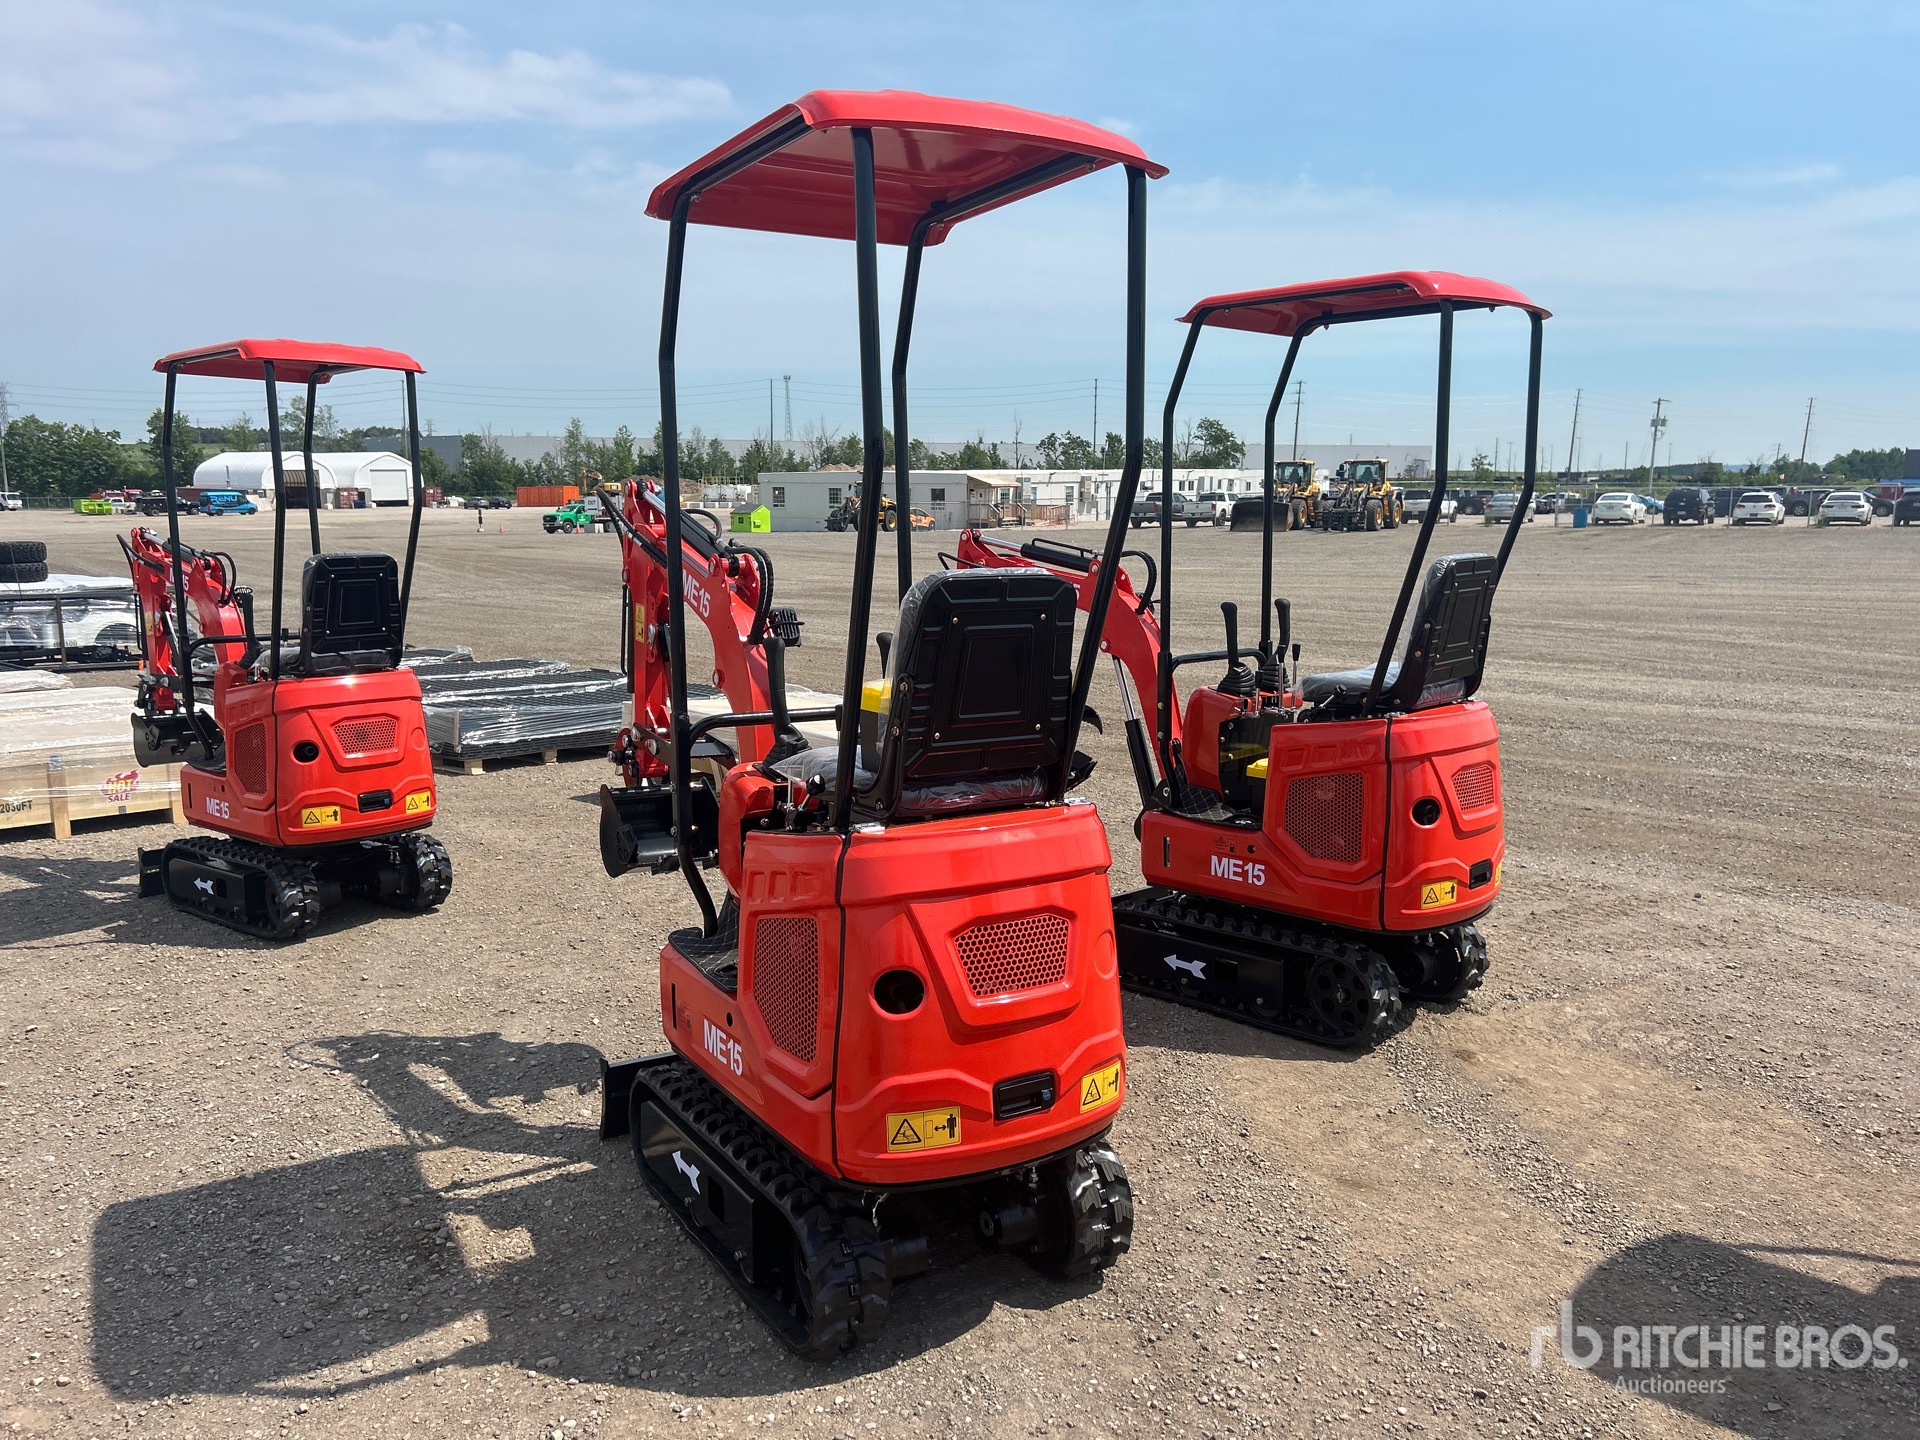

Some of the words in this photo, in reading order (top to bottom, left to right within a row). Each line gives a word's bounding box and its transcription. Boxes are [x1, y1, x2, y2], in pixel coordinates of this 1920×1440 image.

[683, 569, 711, 618] ME15
[108, 793, 130, 803] SALE
[206, 796, 230, 819] ME15
[1211, 855, 1266, 886] ME15
[703, 1018, 743, 1076] ME15
